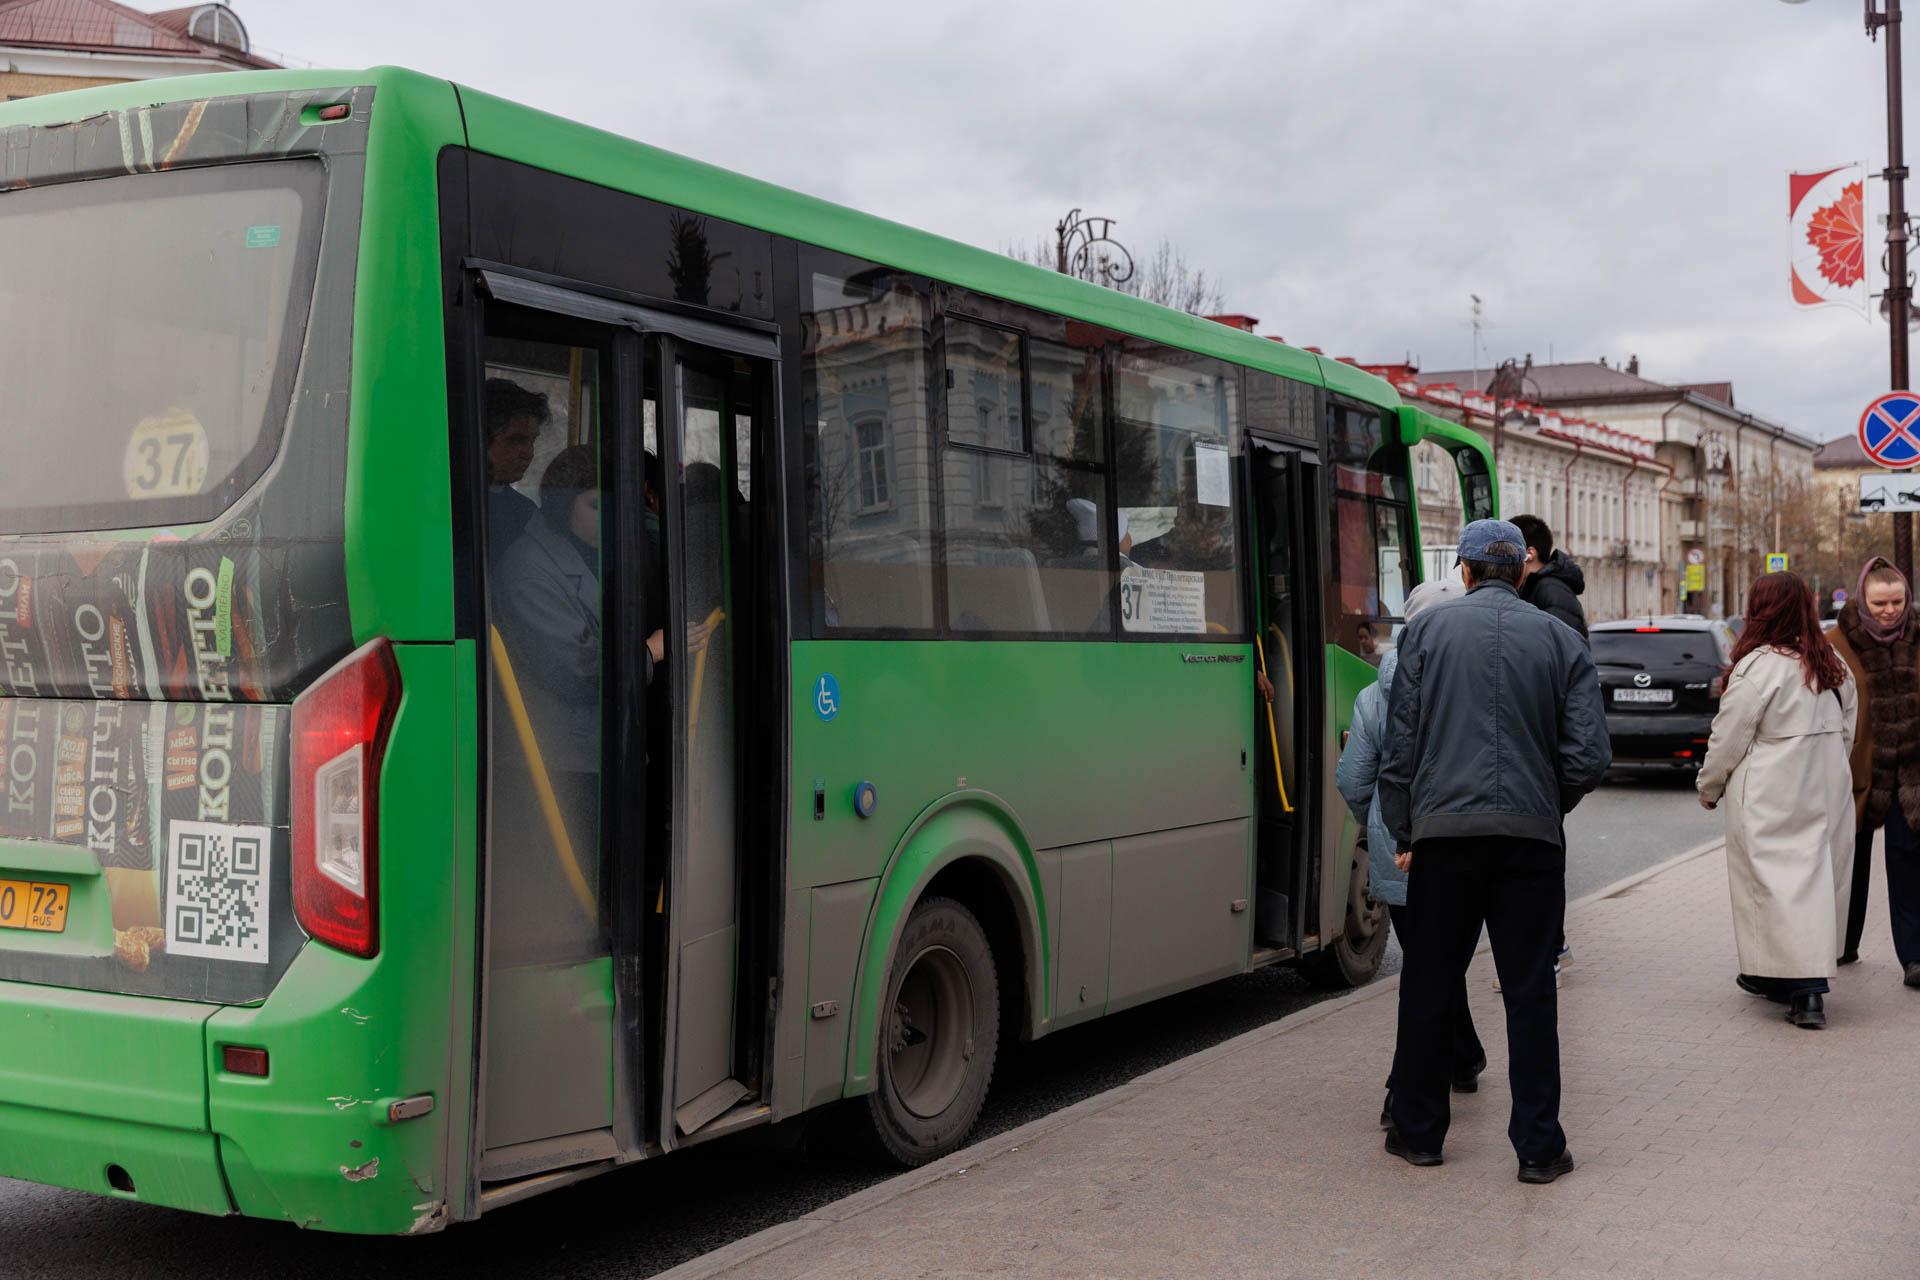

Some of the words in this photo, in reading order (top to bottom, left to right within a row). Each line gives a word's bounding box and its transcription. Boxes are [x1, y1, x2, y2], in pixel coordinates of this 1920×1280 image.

[136, 432, 194, 490] 37
[1122, 584, 1142, 620] 37
[0, 558, 40, 816] КОПЕТТО
[184, 567, 236, 822] КОПЕТТО
[75, 603, 124, 854] КОПЧТТО
[167, 756, 197, 766] СЫТНО
[32, 915, 53, 927] RUS
[33, 886, 58, 915] 72
